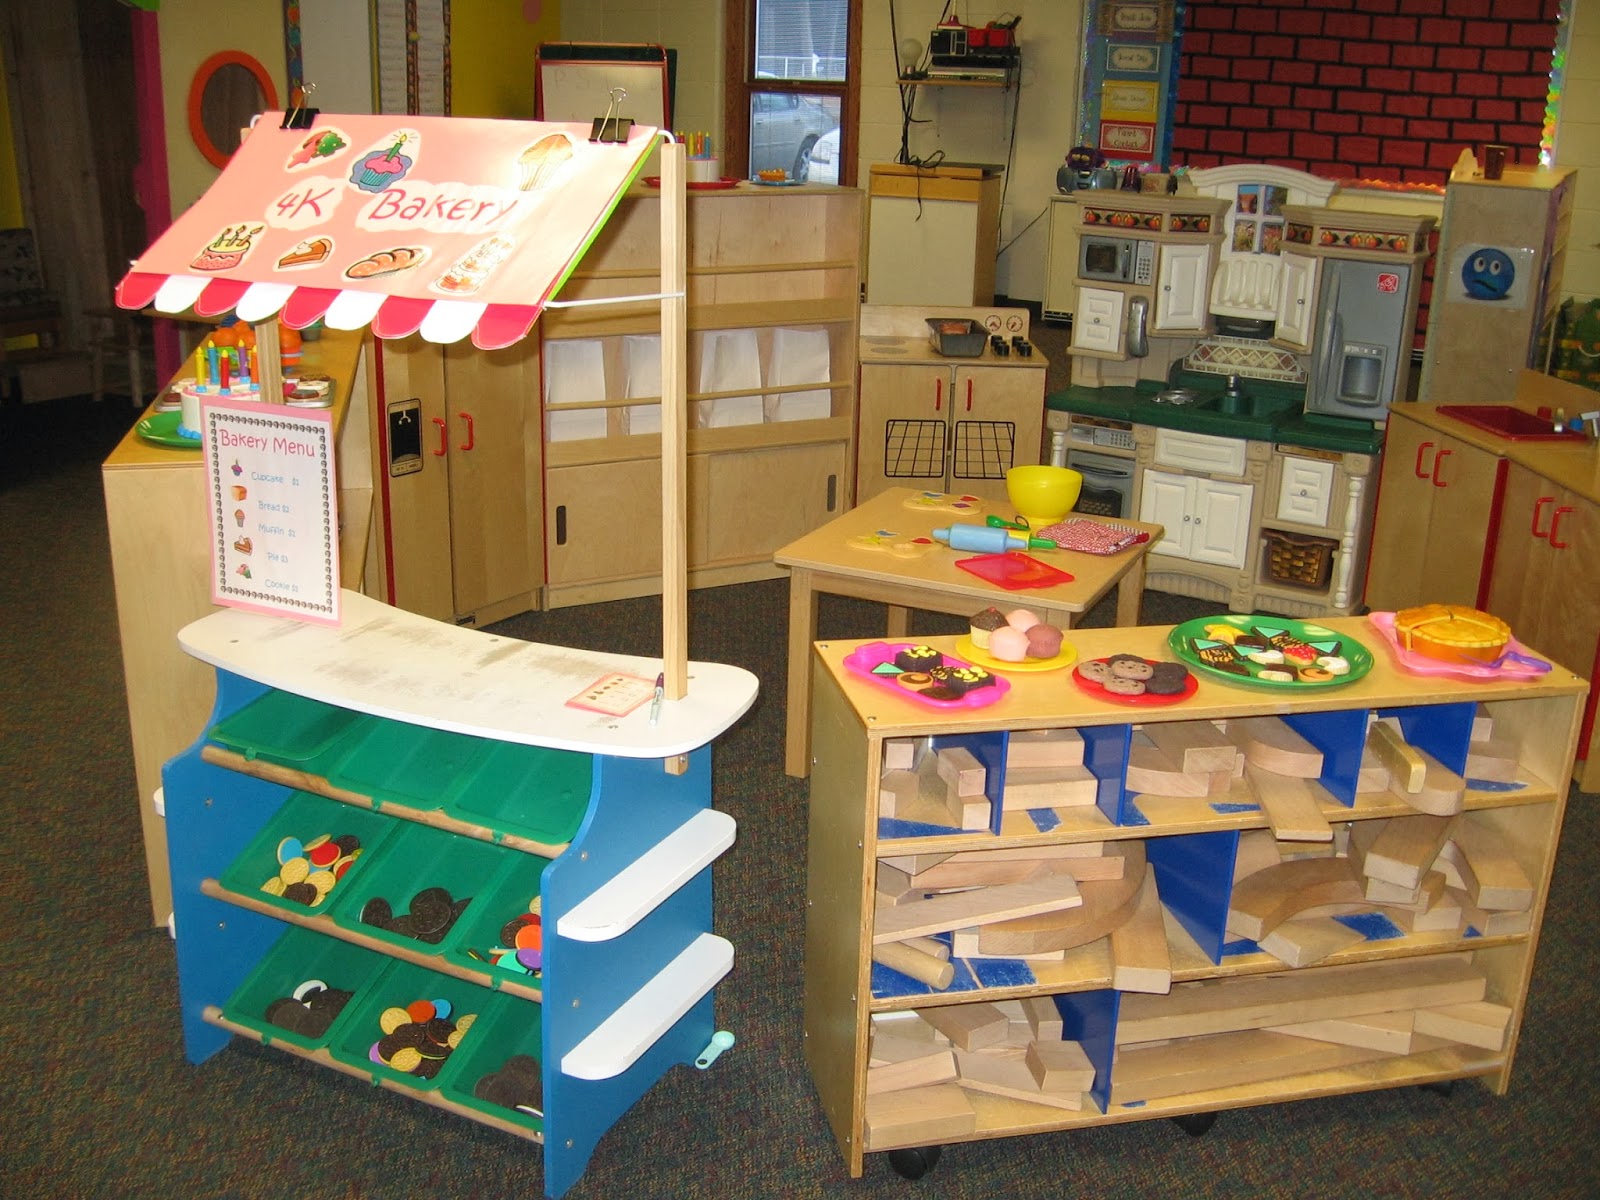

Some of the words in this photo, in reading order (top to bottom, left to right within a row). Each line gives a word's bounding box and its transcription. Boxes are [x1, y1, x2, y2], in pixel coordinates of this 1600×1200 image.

[276, 187, 336, 219] 4K
[368, 187, 519, 226] Bakery
[218, 428, 268, 452] Bakery
[273, 437, 316, 458] Menu
[251, 472, 284, 485] Cupcake
[258, 501, 280, 512] Bread
[258, 524, 285, 536] Muffin
[265, 579, 290, 591] Cookie
